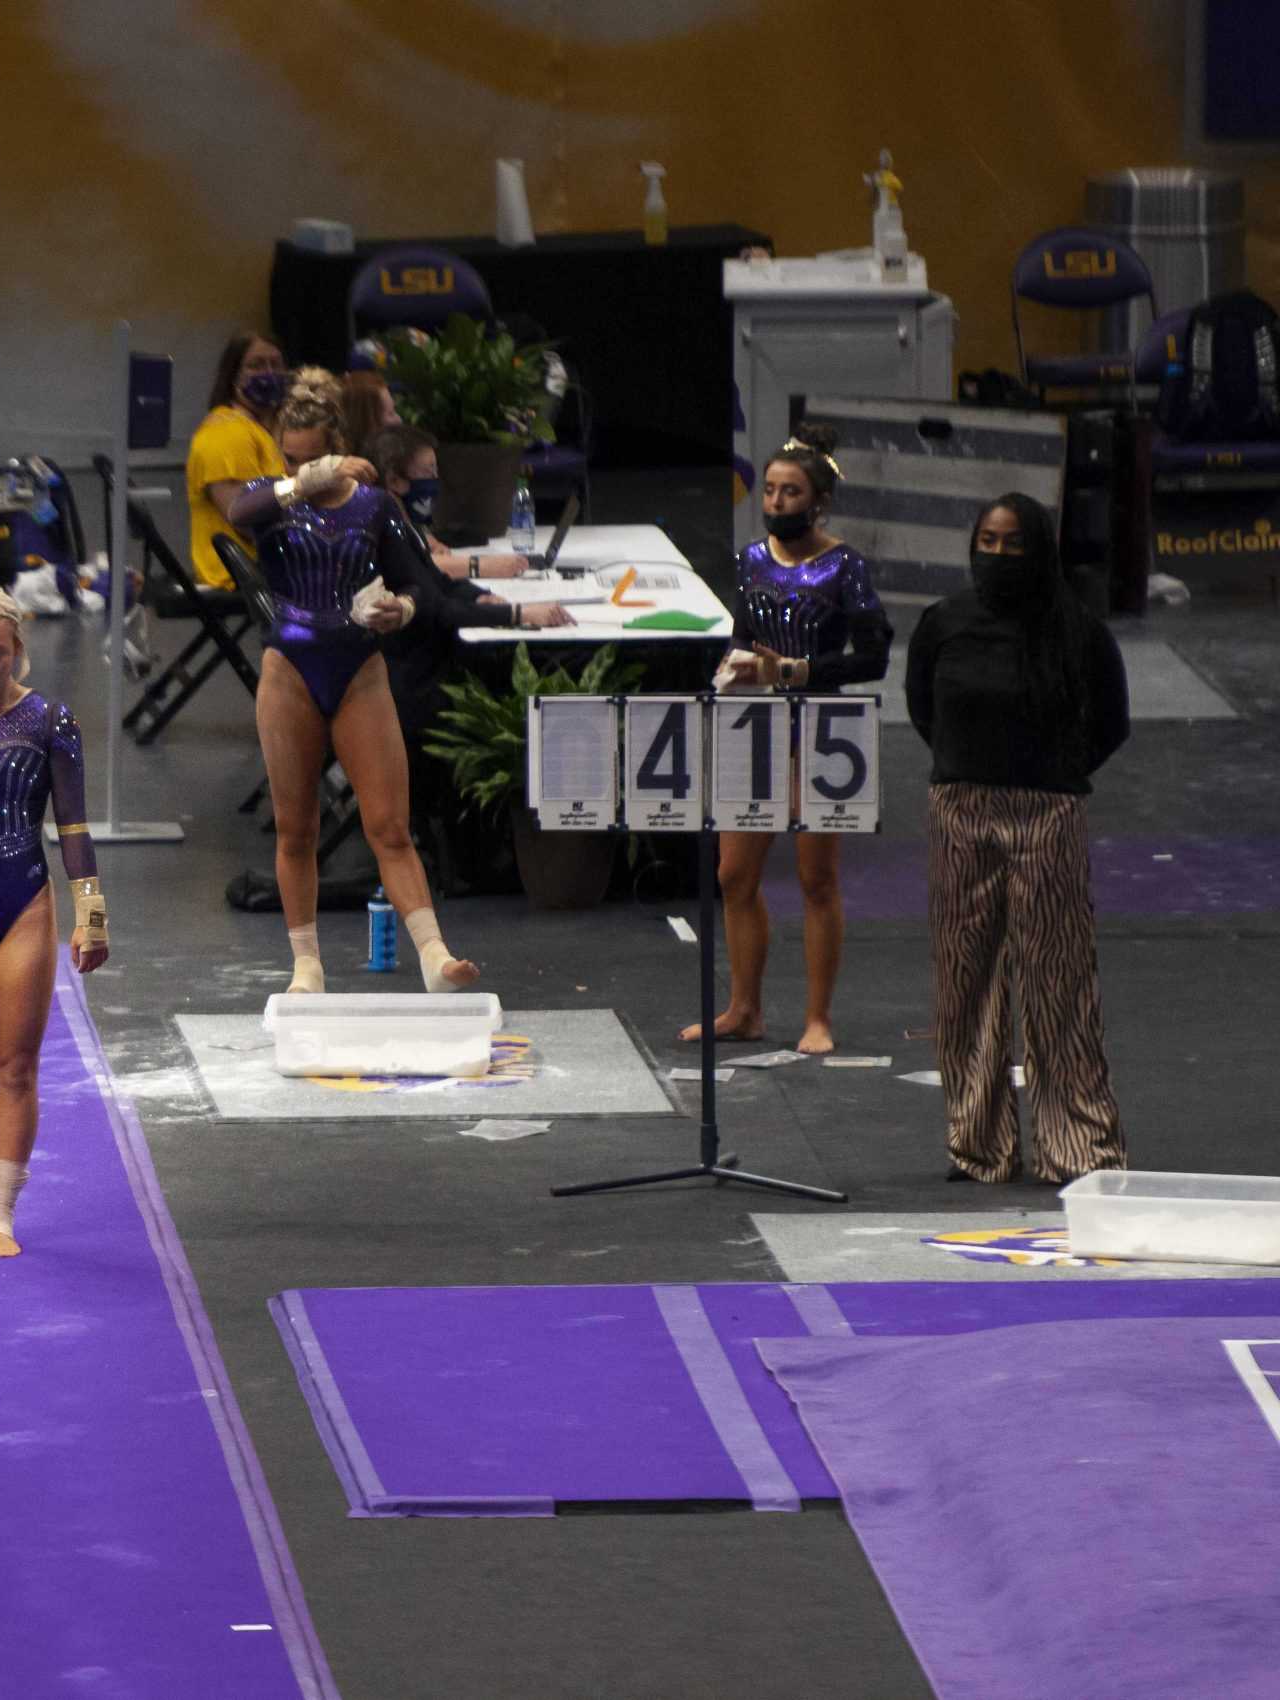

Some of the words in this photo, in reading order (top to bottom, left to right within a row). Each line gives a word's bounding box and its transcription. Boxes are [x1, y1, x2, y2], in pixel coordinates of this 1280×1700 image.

[1044, 249, 1116, 279] LSU
[381, 268, 454, 295] LSU
[636, 702, 691, 799] 4
[730, 702, 771, 800] 1
[811, 703, 868, 801] 5
